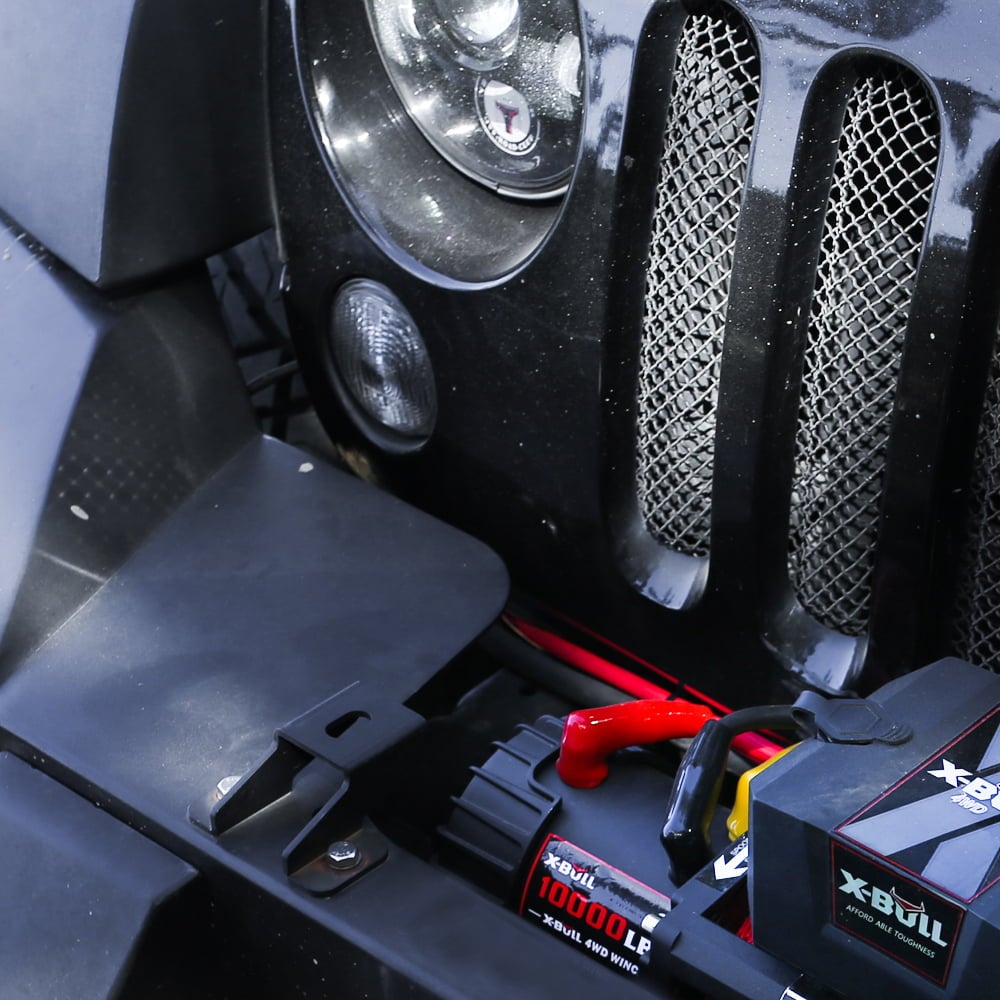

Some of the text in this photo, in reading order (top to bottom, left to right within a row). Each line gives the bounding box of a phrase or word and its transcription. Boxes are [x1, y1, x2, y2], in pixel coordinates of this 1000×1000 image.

[544, 852, 596, 890] X-BULL
[838, 868, 948, 947] X-BULL
[846, 904, 935, 959] AFFORD ABLE TOUGHNESS
[542, 913, 639, 975] X-BULL 4WD WINC
